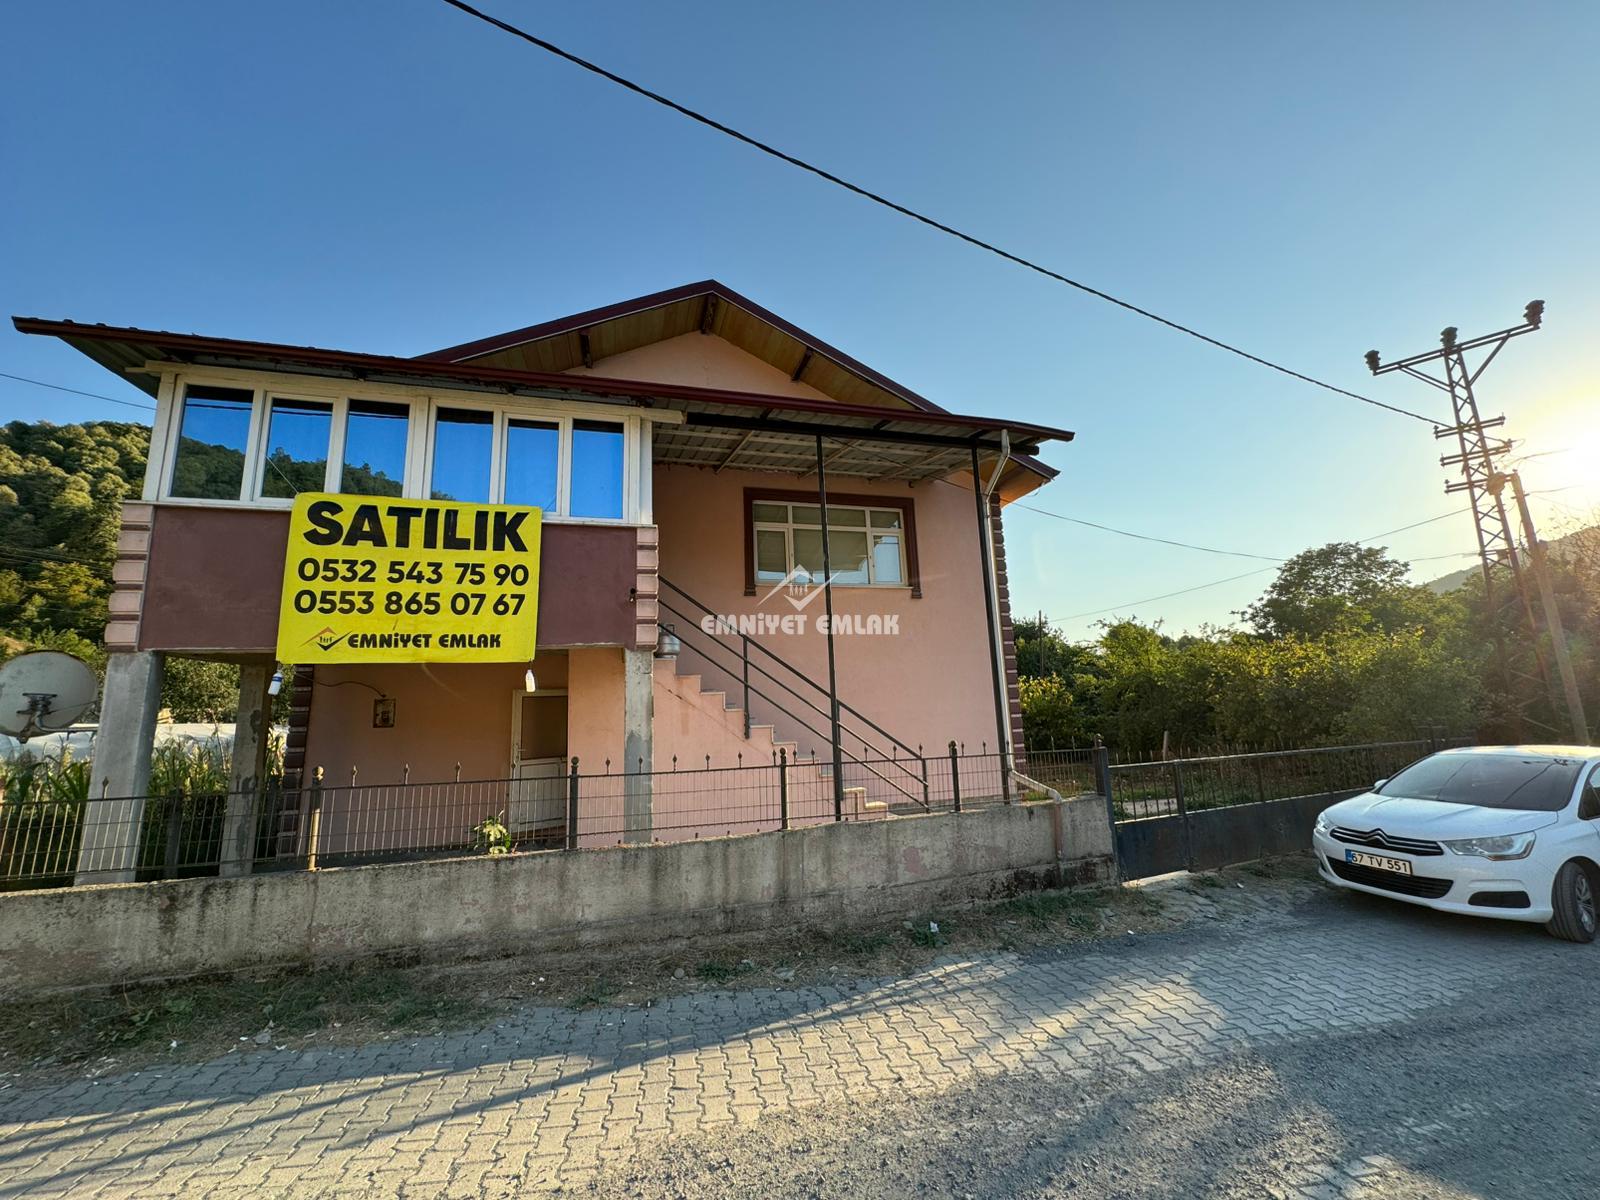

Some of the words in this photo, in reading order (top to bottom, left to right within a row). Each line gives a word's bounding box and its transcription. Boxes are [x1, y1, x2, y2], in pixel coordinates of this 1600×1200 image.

[303, 500, 530, 552] SATILIK
[298, 557, 377, 583] 0532
[386, 560, 443, 585] 543
[454, 562, 486, 586] 75
[493, 563, 530, 586] 90
[294, 589, 374, 614] 0553
[384, 591, 441, 616] 865
[450, 593, 487, 616] 07
[492, 593, 526, 616] 67
[438, 633, 501, 649] EMLAK
[1352, 853, 1364, 863] 67
[1367, 855, 1383, 868] TV
[1387, 860, 1408, 873] 551
